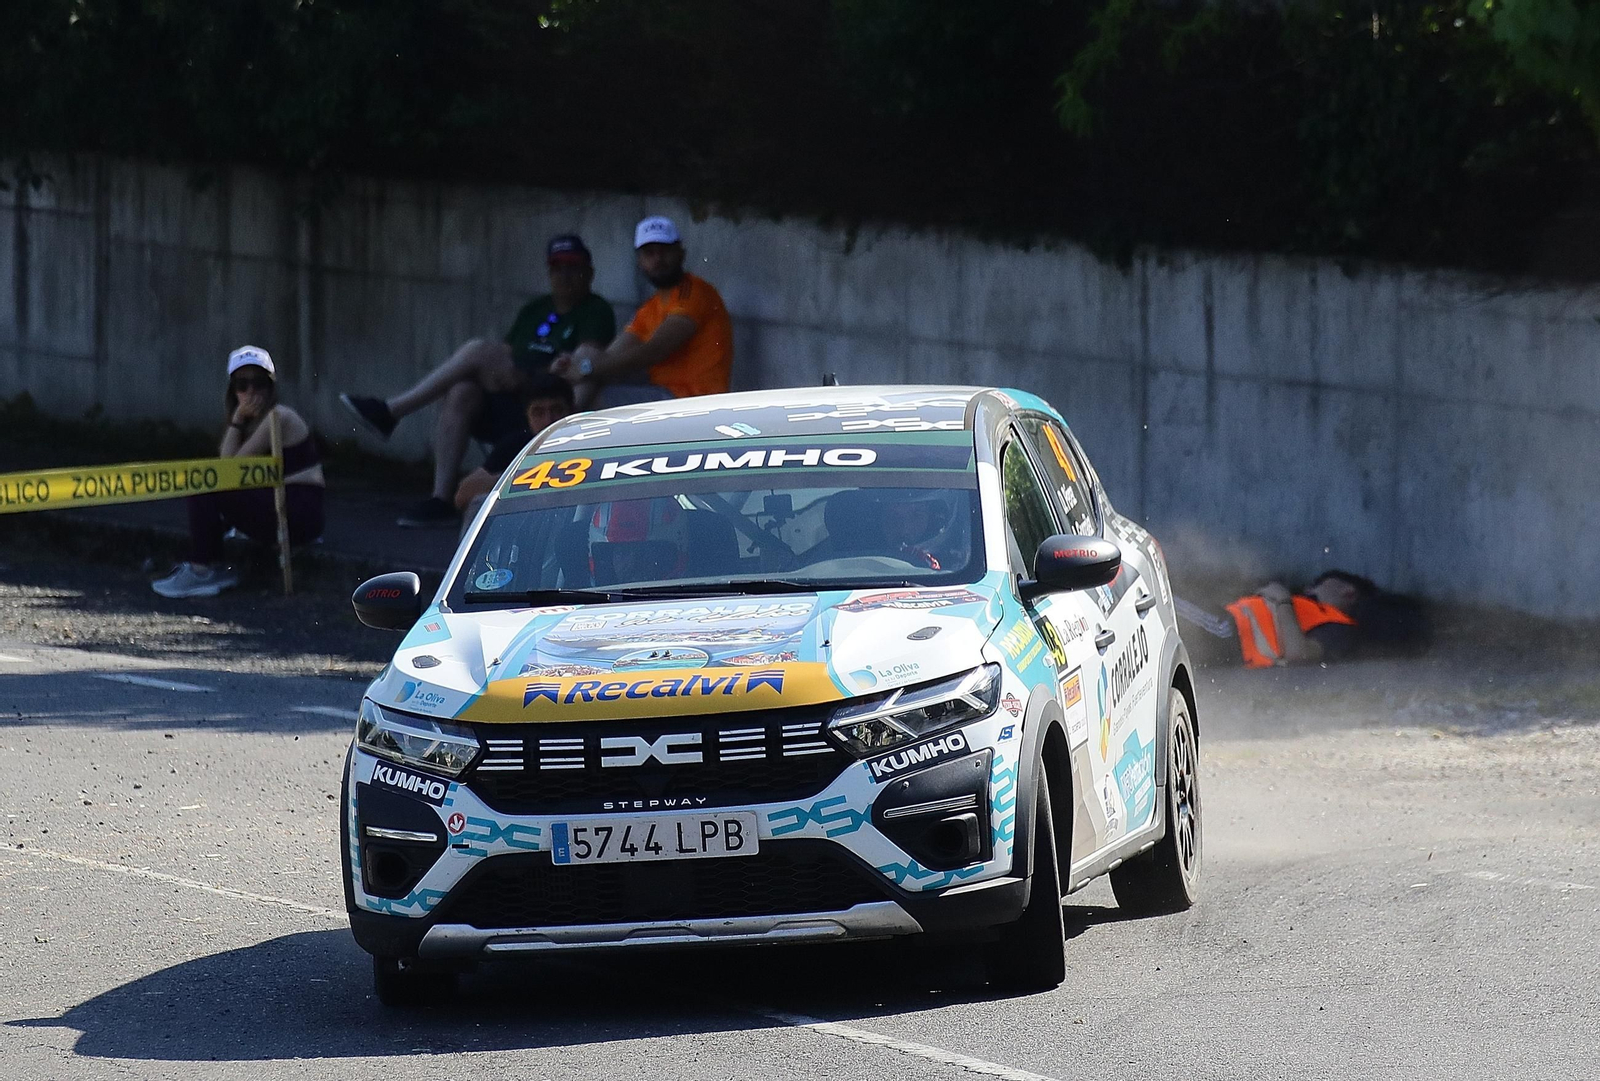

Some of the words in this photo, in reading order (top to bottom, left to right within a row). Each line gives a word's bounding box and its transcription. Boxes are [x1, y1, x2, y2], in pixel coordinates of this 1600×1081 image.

[512, 458, 593, 489] 43
[600, 448, 877, 480] KUMHO
[0, 480, 50, 504] LICO
[71, 475, 127, 499] ZONA
[131, 467, 218, 494] PUBLICO
[1053, 549, 1098, 559] MOTRIO
[878, 669, 893, 678] La
[893, 662, 920, 674] Oliva
[1111, 624, 1149, 709] CORRALEJO
[414, 690, 425, 699] La
[425, 692, 446, 704] Oliva
[563, 673, 744, 704] Recalvi
[872, 732, 966, 777] KUMHO
[373, 764, 445, 800] KUMHO
[603, 797, 707, 810] STEPWAY
[558, 847, 565, 857] E
[573, 823, 663, 860] 5744
[676, 819, 744, 854] LPB
